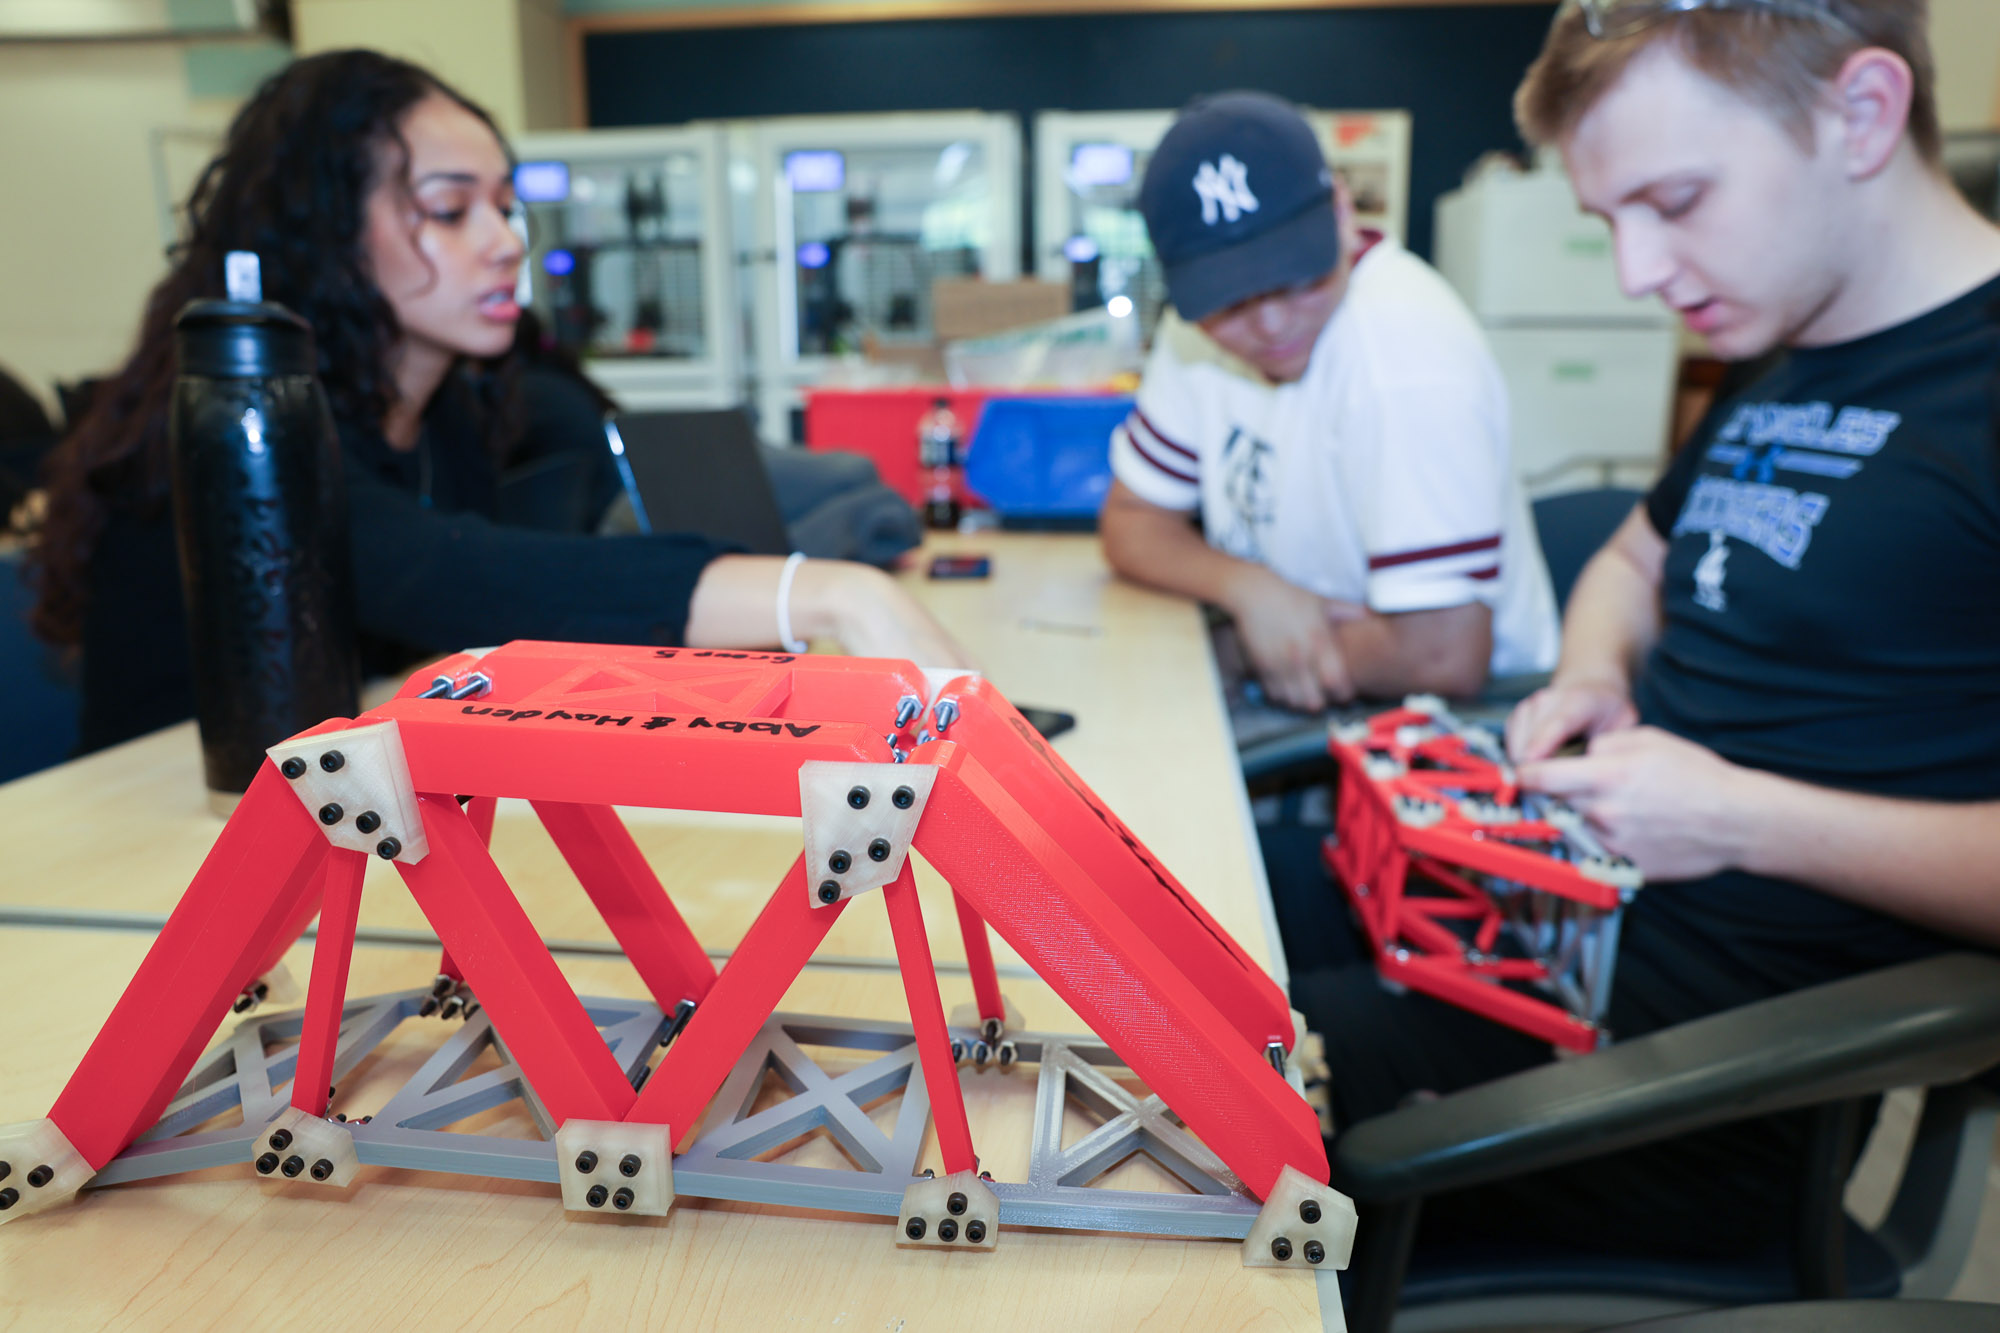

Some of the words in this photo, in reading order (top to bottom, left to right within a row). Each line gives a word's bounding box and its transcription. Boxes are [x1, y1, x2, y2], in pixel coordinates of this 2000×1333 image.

[1193, 153, 1259, 225] NY
[653, 650, 679, 659] 5
[693, 651, 796, 664] Group
[461, 705, 634, 726] Hayden
[640, 716, 677, 730] &
[687, 716, 821, 738] Abby
